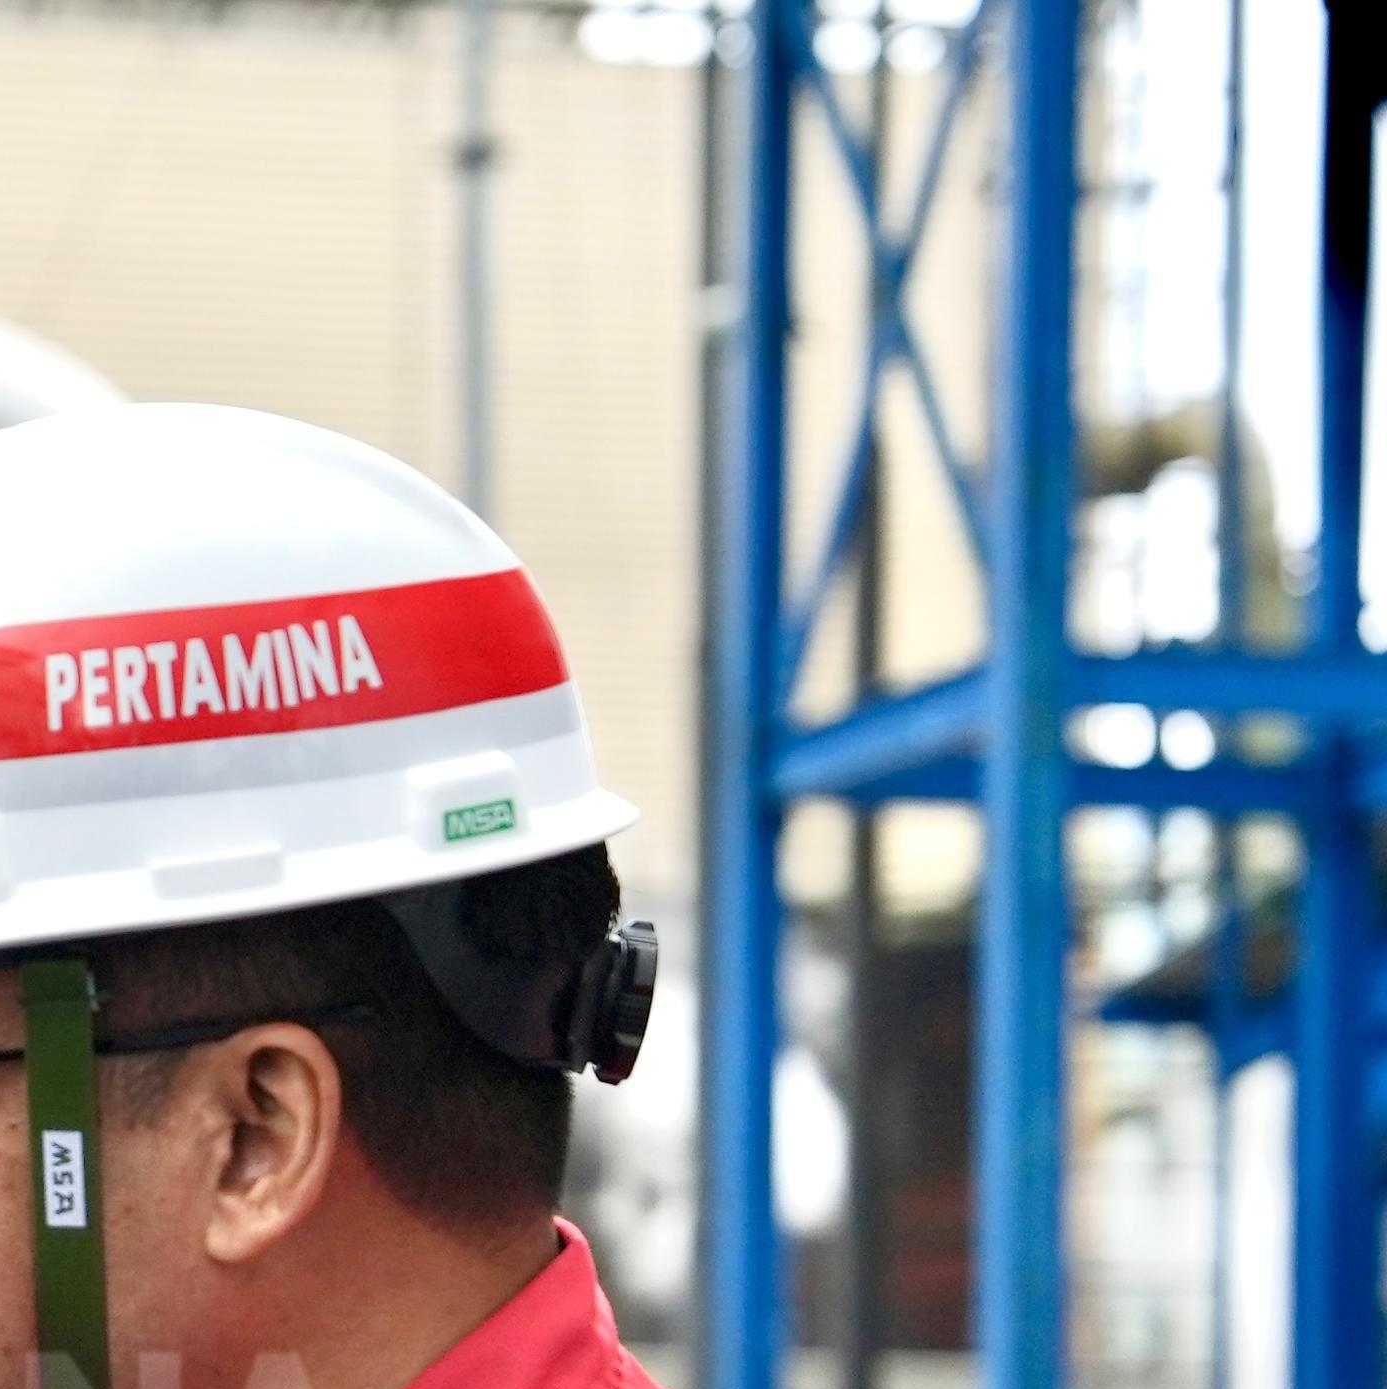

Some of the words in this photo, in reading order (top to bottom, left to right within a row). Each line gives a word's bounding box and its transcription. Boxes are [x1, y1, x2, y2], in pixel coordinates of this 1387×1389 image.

[45, 614, 383, 733] PERTAMINA
[447, 801, 512, 838] MSA
[50, 1141, 75, 1216] MSA
